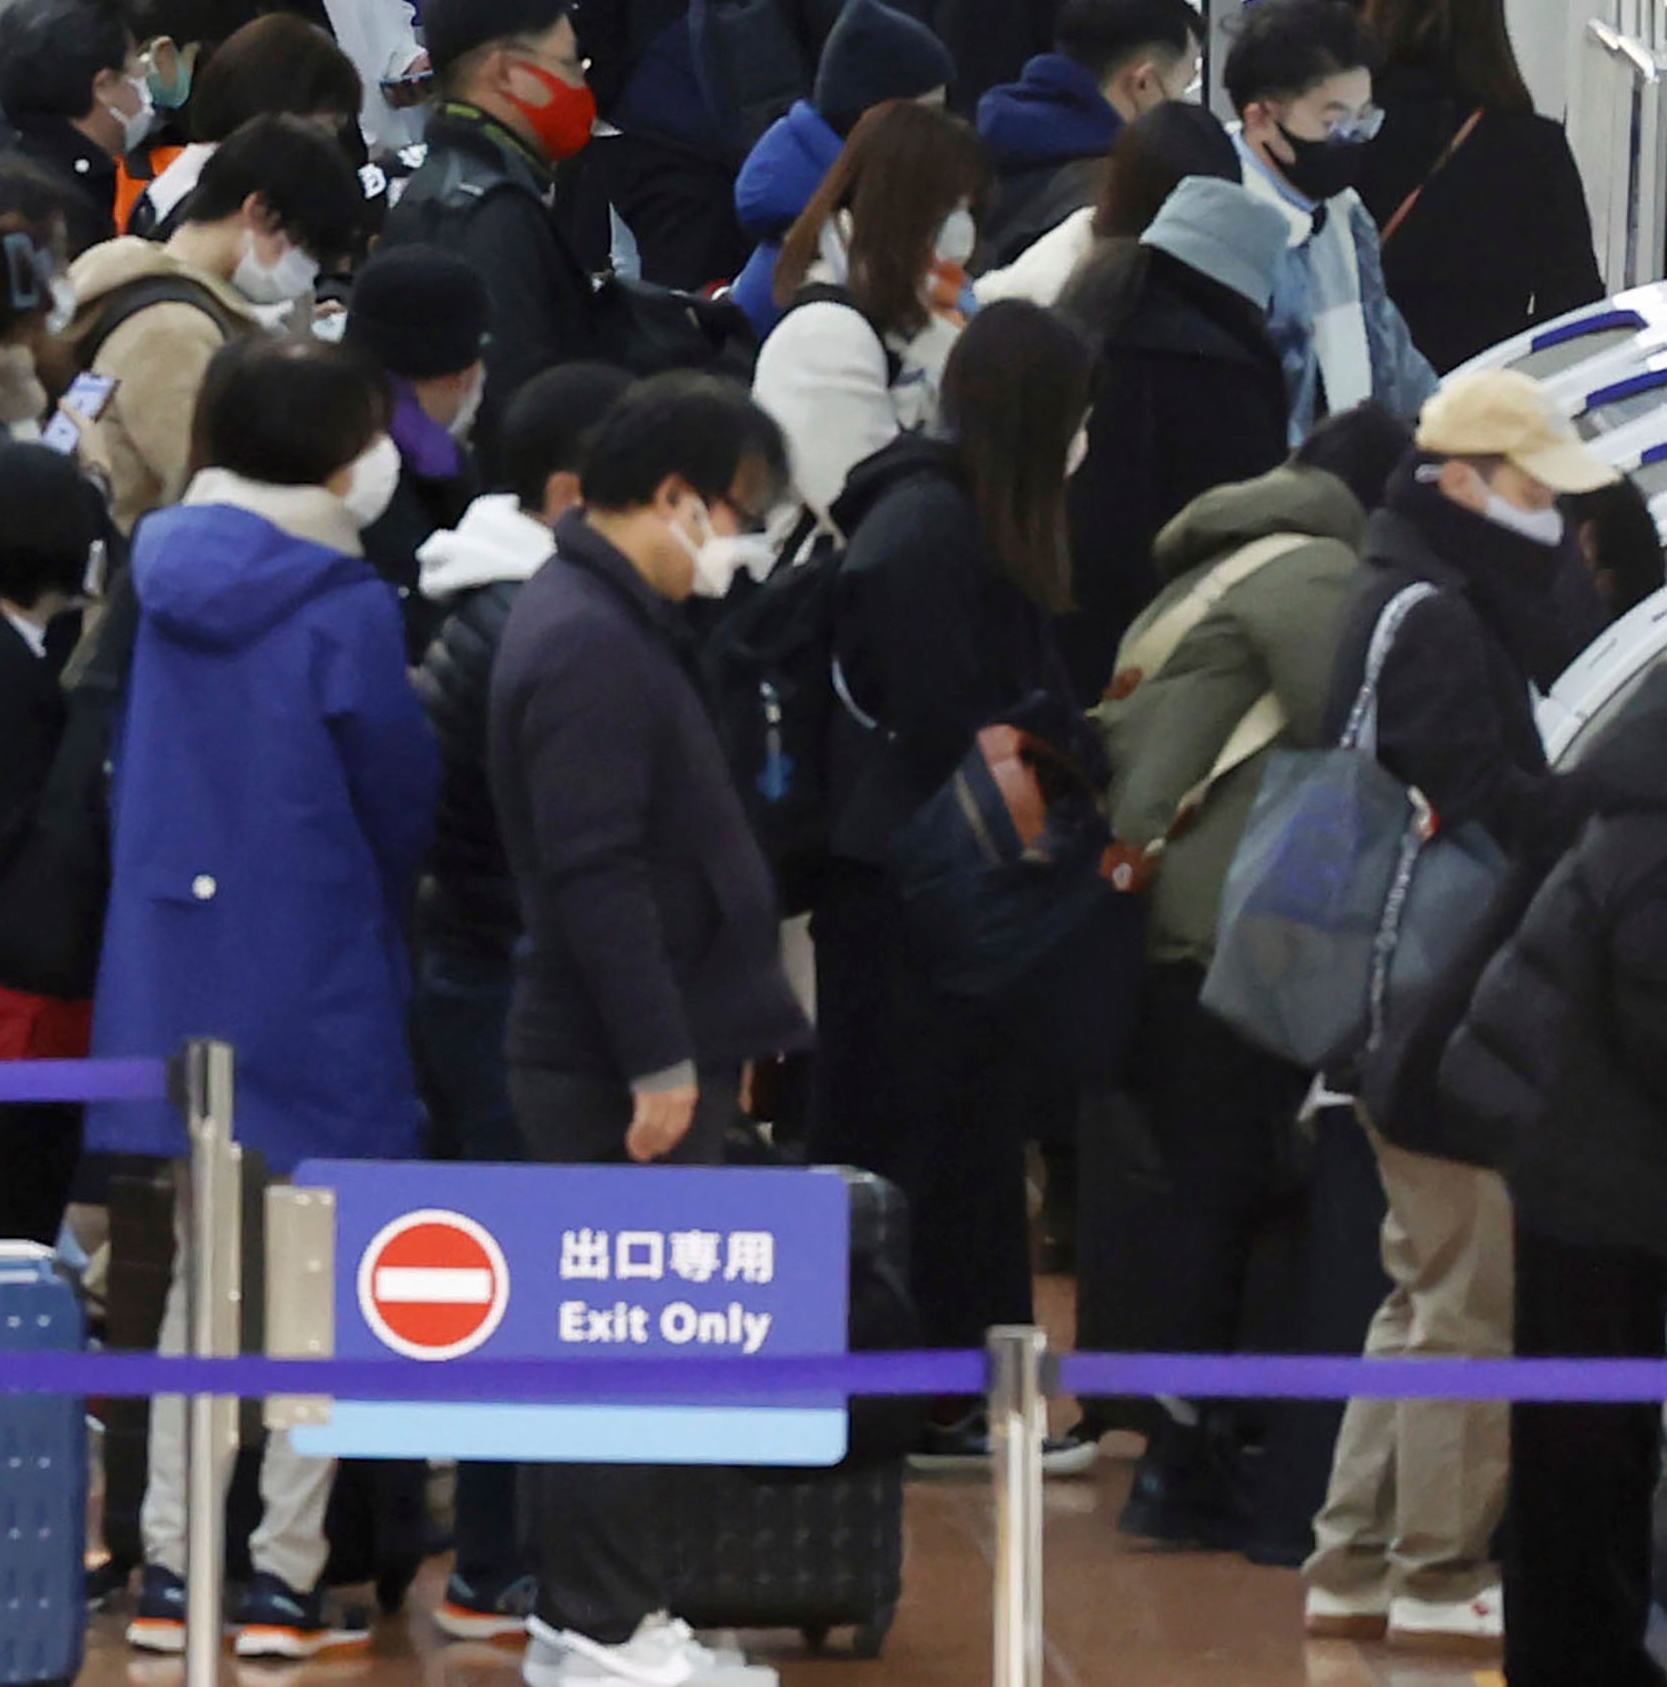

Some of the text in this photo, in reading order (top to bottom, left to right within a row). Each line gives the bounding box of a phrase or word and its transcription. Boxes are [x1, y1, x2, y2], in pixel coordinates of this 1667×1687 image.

[559, 1227, 775, 1284] 出口専用
[559, 1300, 773, 1355] Exit Only
